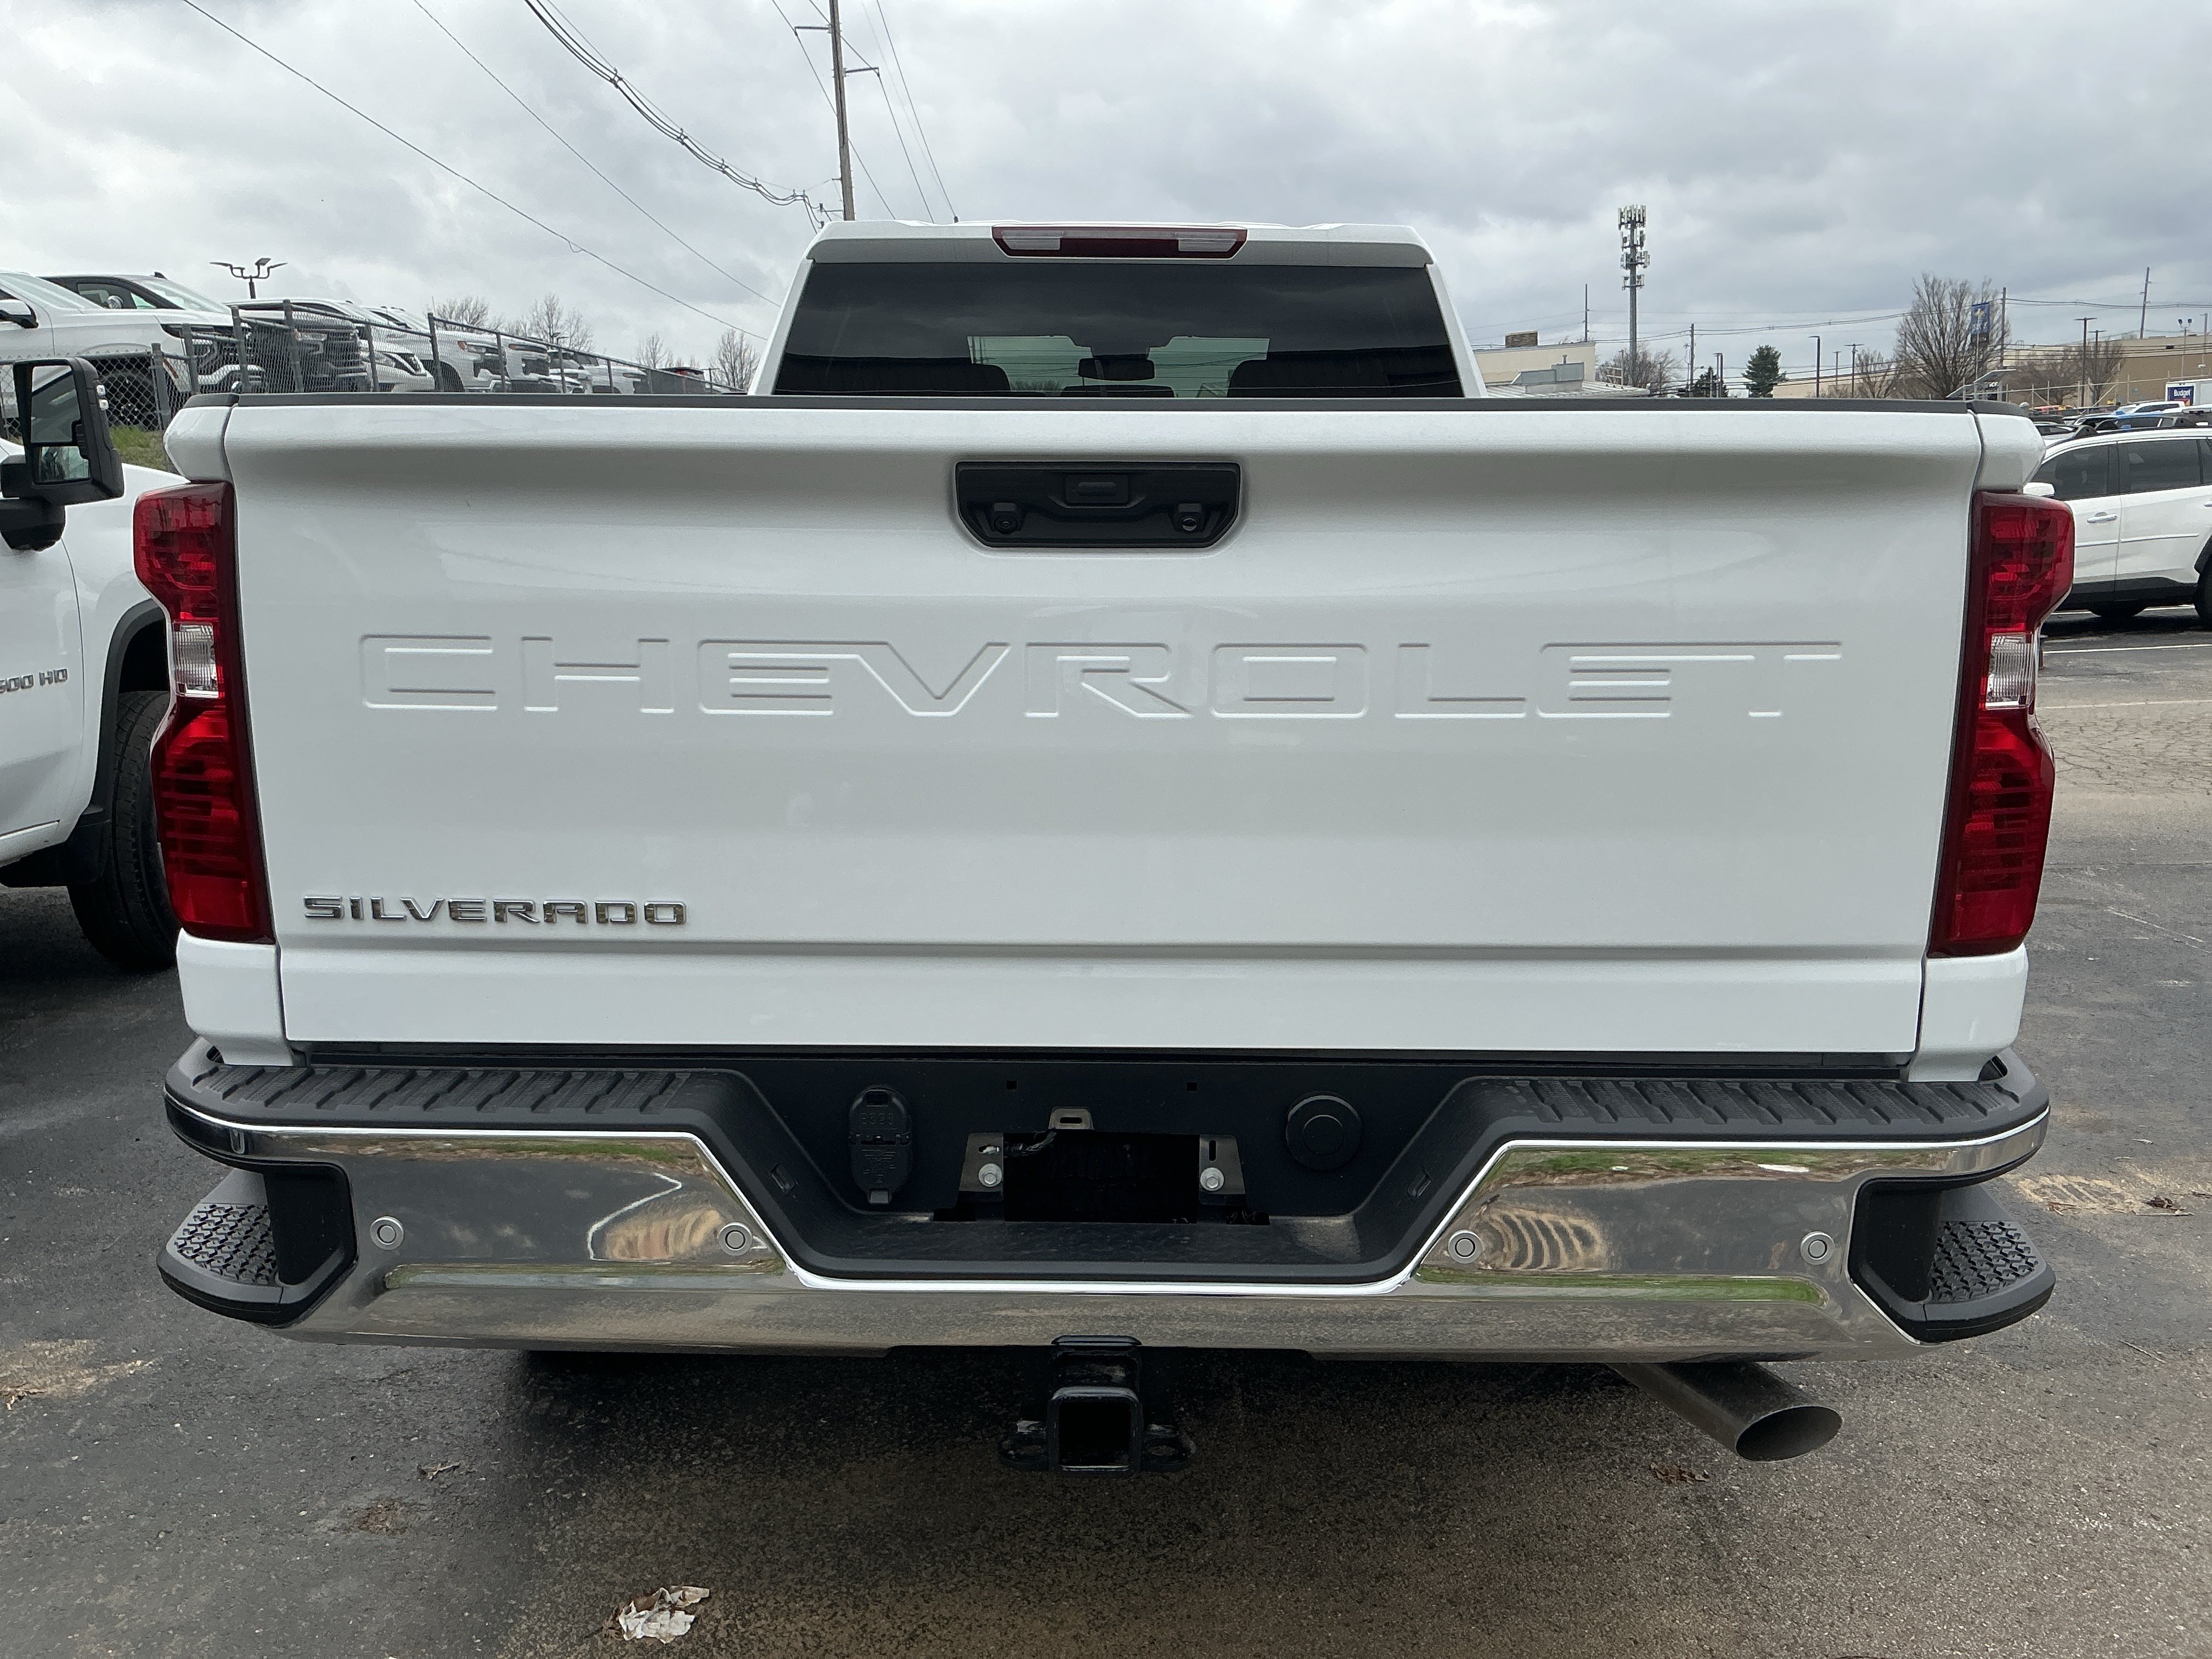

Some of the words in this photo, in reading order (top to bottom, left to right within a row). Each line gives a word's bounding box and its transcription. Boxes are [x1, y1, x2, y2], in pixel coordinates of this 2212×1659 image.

[2174, 389, 2191, 398] Budget
[39, 668, 68, 686] HD
[359, 635, 1842, 720] CHEVROLET
[303, 895, 687, 924] SILVERADO
